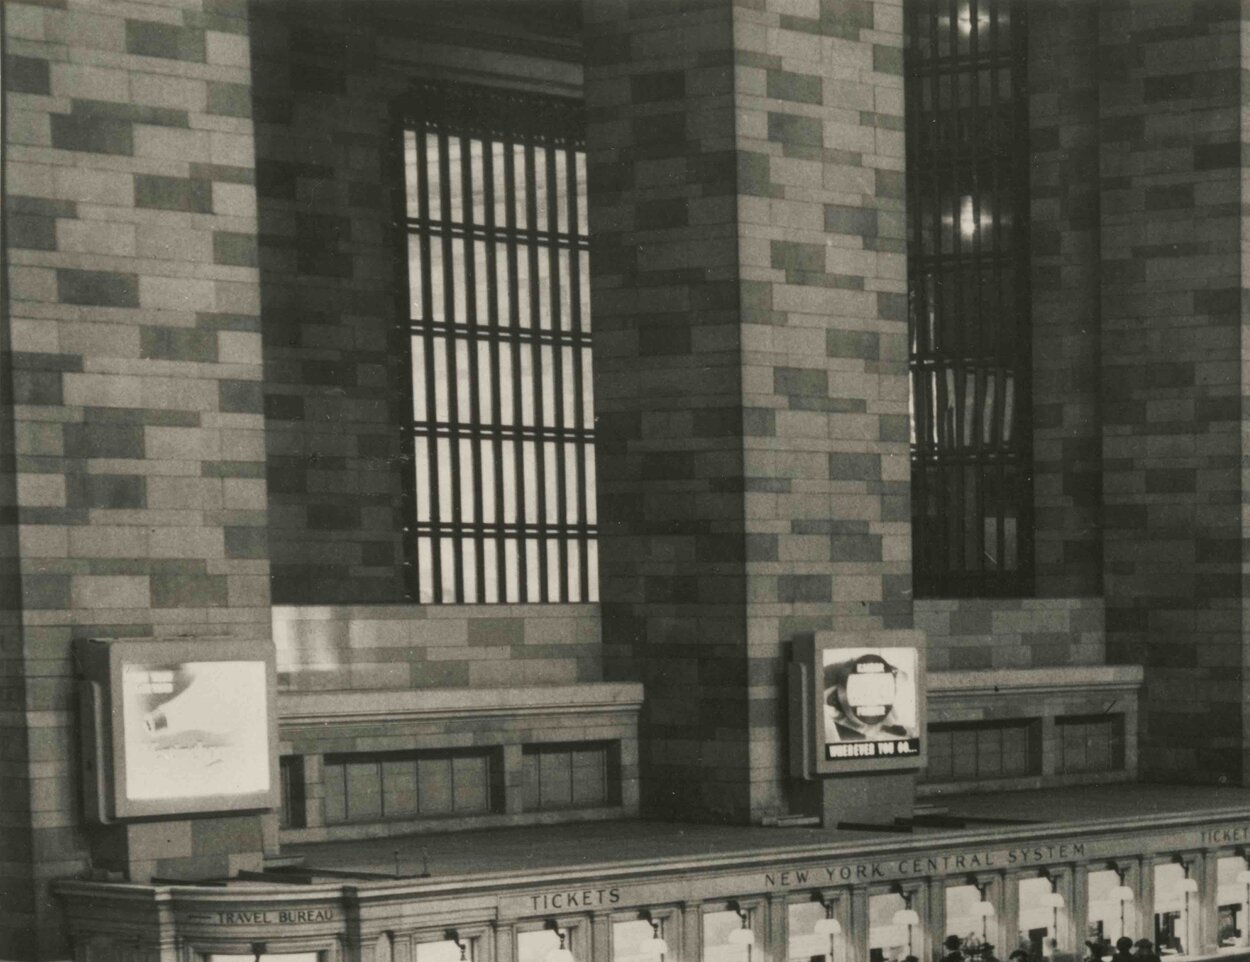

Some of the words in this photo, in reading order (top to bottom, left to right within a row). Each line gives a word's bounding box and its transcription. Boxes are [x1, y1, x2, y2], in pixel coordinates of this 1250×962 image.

[829, 743, 875, 758] WHEREVER
[877, 742, 894, 755] YOU
[765, 871, 809, 888] NEW
[826, 863, 885, 881] YORK
[898, 853, 994, 875] CENTRAL
[1008, 843, 1085, 863] SYSTEM
[530, 888, 621, 911] TICKETS
[218, 911, 268, 925] TRAVEL
[278, 908, 334, 924] BUREAU
